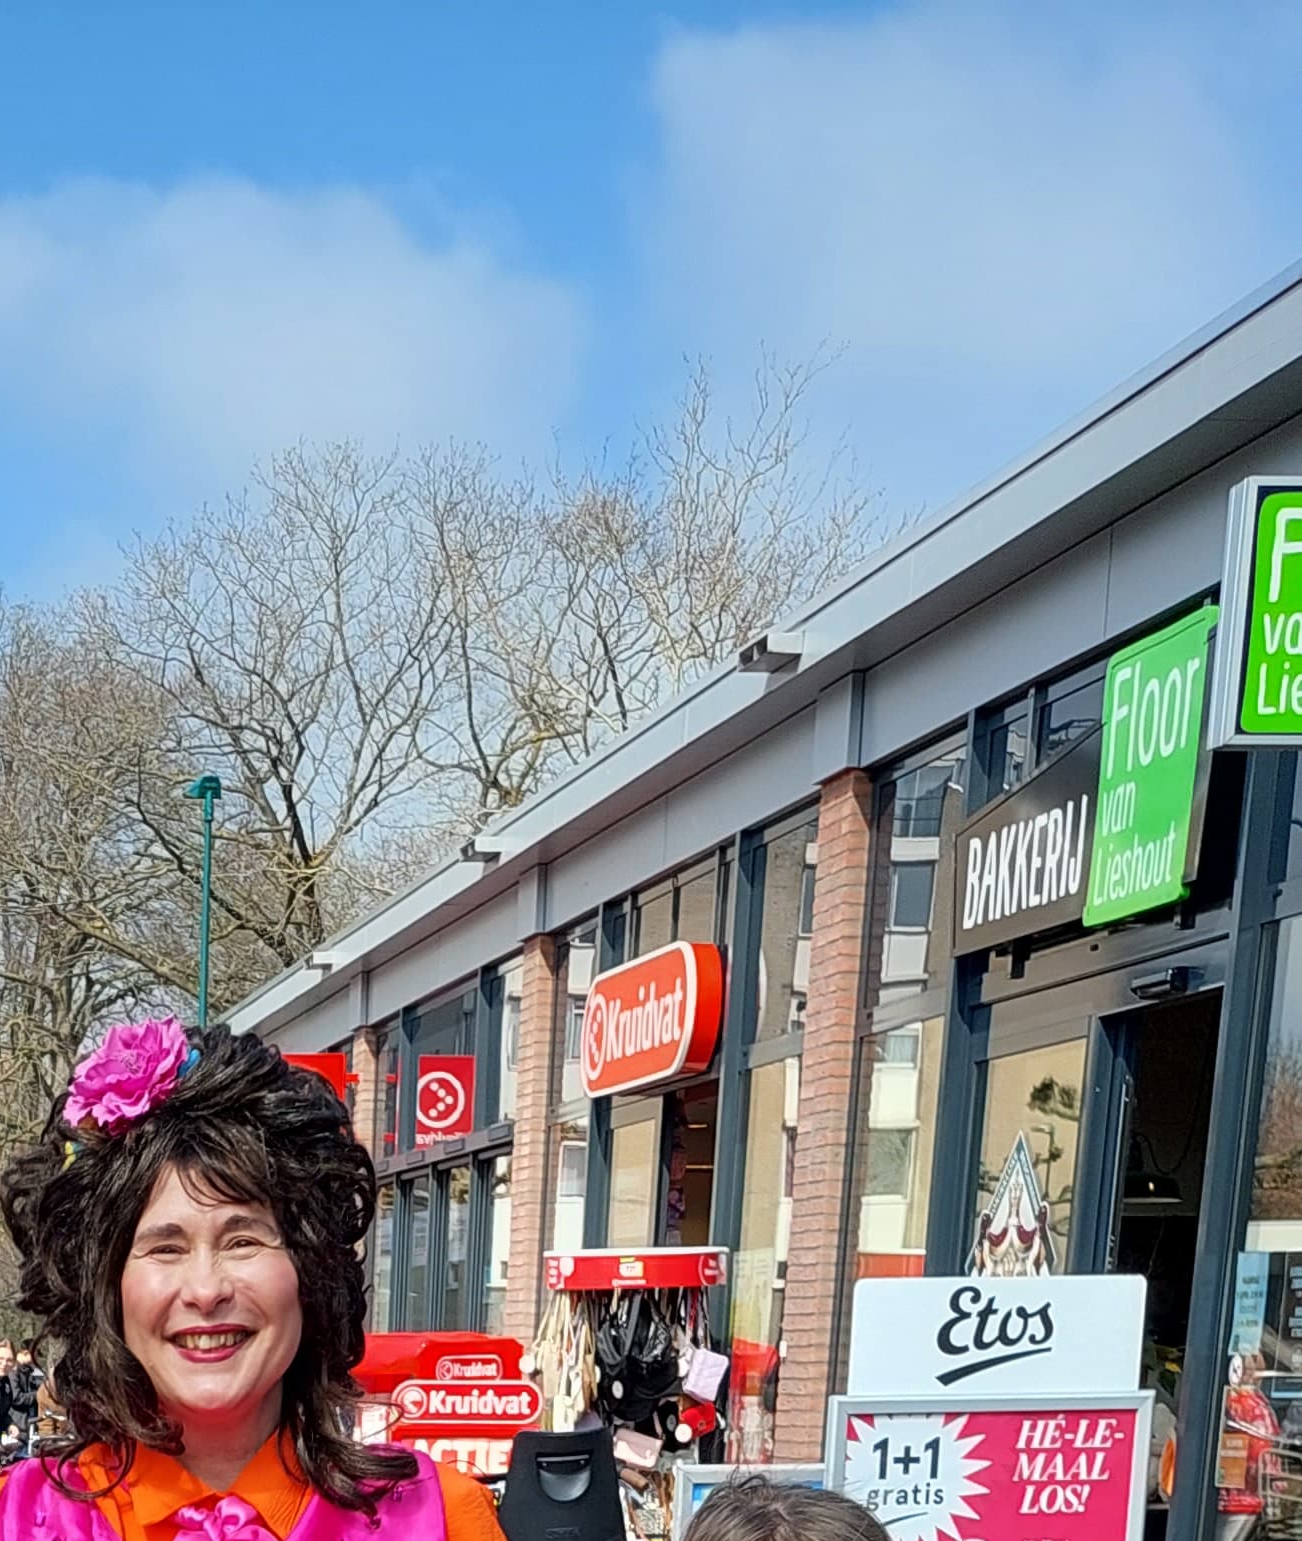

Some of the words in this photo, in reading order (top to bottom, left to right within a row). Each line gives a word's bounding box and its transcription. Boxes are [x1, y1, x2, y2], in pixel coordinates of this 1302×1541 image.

[1106, 657, 1201, 780] Floor
[1101, 781, 1136, 837] van
[962, 793, 1089, 930] BAKKERIJ
[1092, 820, 1176, 907] Lieshout
[605, 976, 684, 1063] Kruidvat
[936, 1285, 1054, 1356] Etos
[452, 1361, 498, 1378] Kruidvat
[428, 1388, 532, 1415] Kruidvat
[872, 1436, 941, 1480] 1+1
[1012, 1452, 1110, 1482] MAAL
[865, 1482, 944, 1511] gratis
[1019, 1484, 1091, 1514] LOS!
